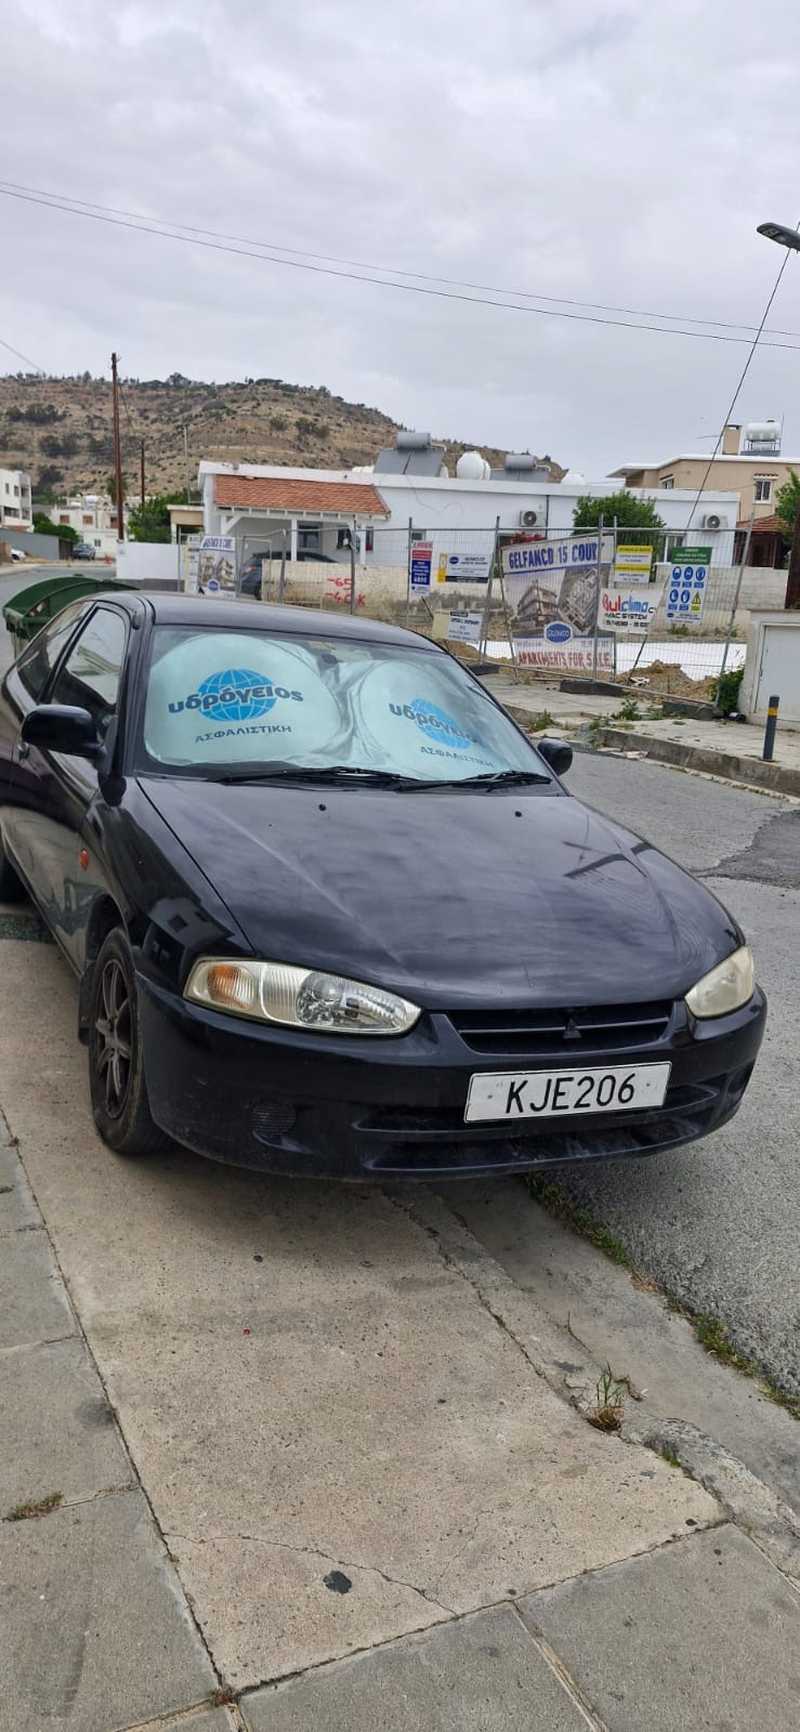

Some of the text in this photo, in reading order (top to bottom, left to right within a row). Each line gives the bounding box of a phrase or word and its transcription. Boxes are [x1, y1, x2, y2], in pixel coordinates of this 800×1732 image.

[508, 547, 554, 569] GELFANCO
[558, 546, 568, 563] 15
[572, 542, 606, 562] COUR
[586, 652, 611, 670] SLE
[505, 1073, 636, 1114] KJE206
